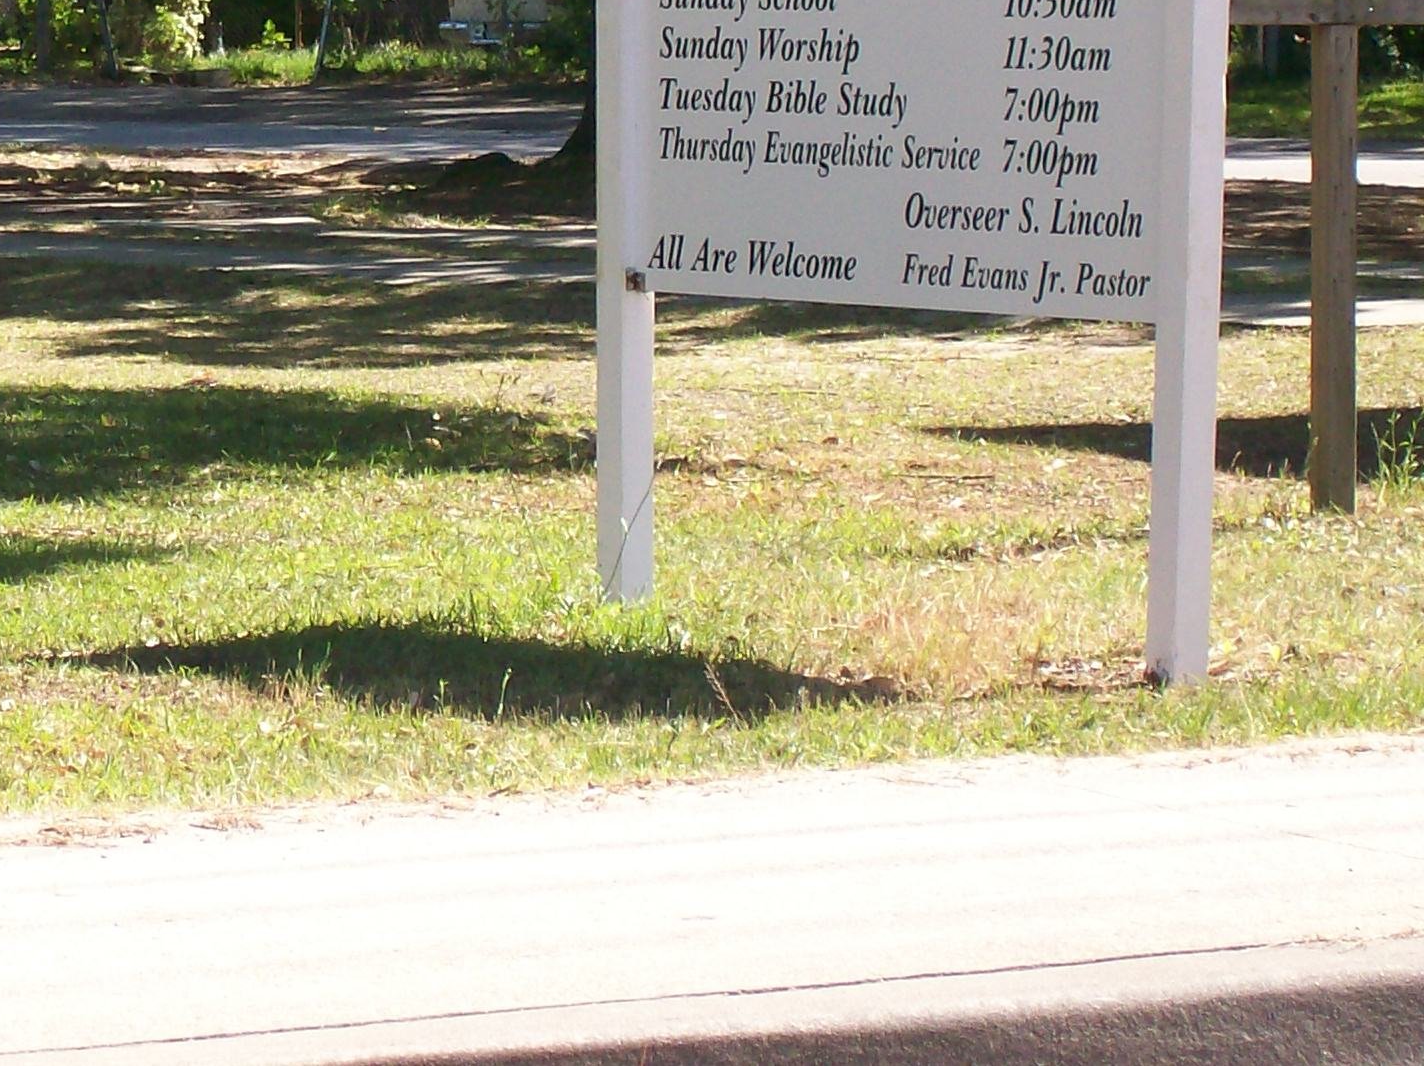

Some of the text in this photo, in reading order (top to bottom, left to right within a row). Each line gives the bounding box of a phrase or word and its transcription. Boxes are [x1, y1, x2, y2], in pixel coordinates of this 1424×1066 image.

[659, 25, 1111, 76] Sunday Worship 11:30am
[659, 77, 1099, 136] Tuesday Bible Study 7:00pm
[659, 125, 1099, 188] Thursday Evangelistic Service 7:00pm
[904, 191, 1143, 238] Overseer S. Lincoln
[647, 234, 858, 281] All Are Welcome
[901, 253, 1152, 305] Fred Evans Jr. Pastor
